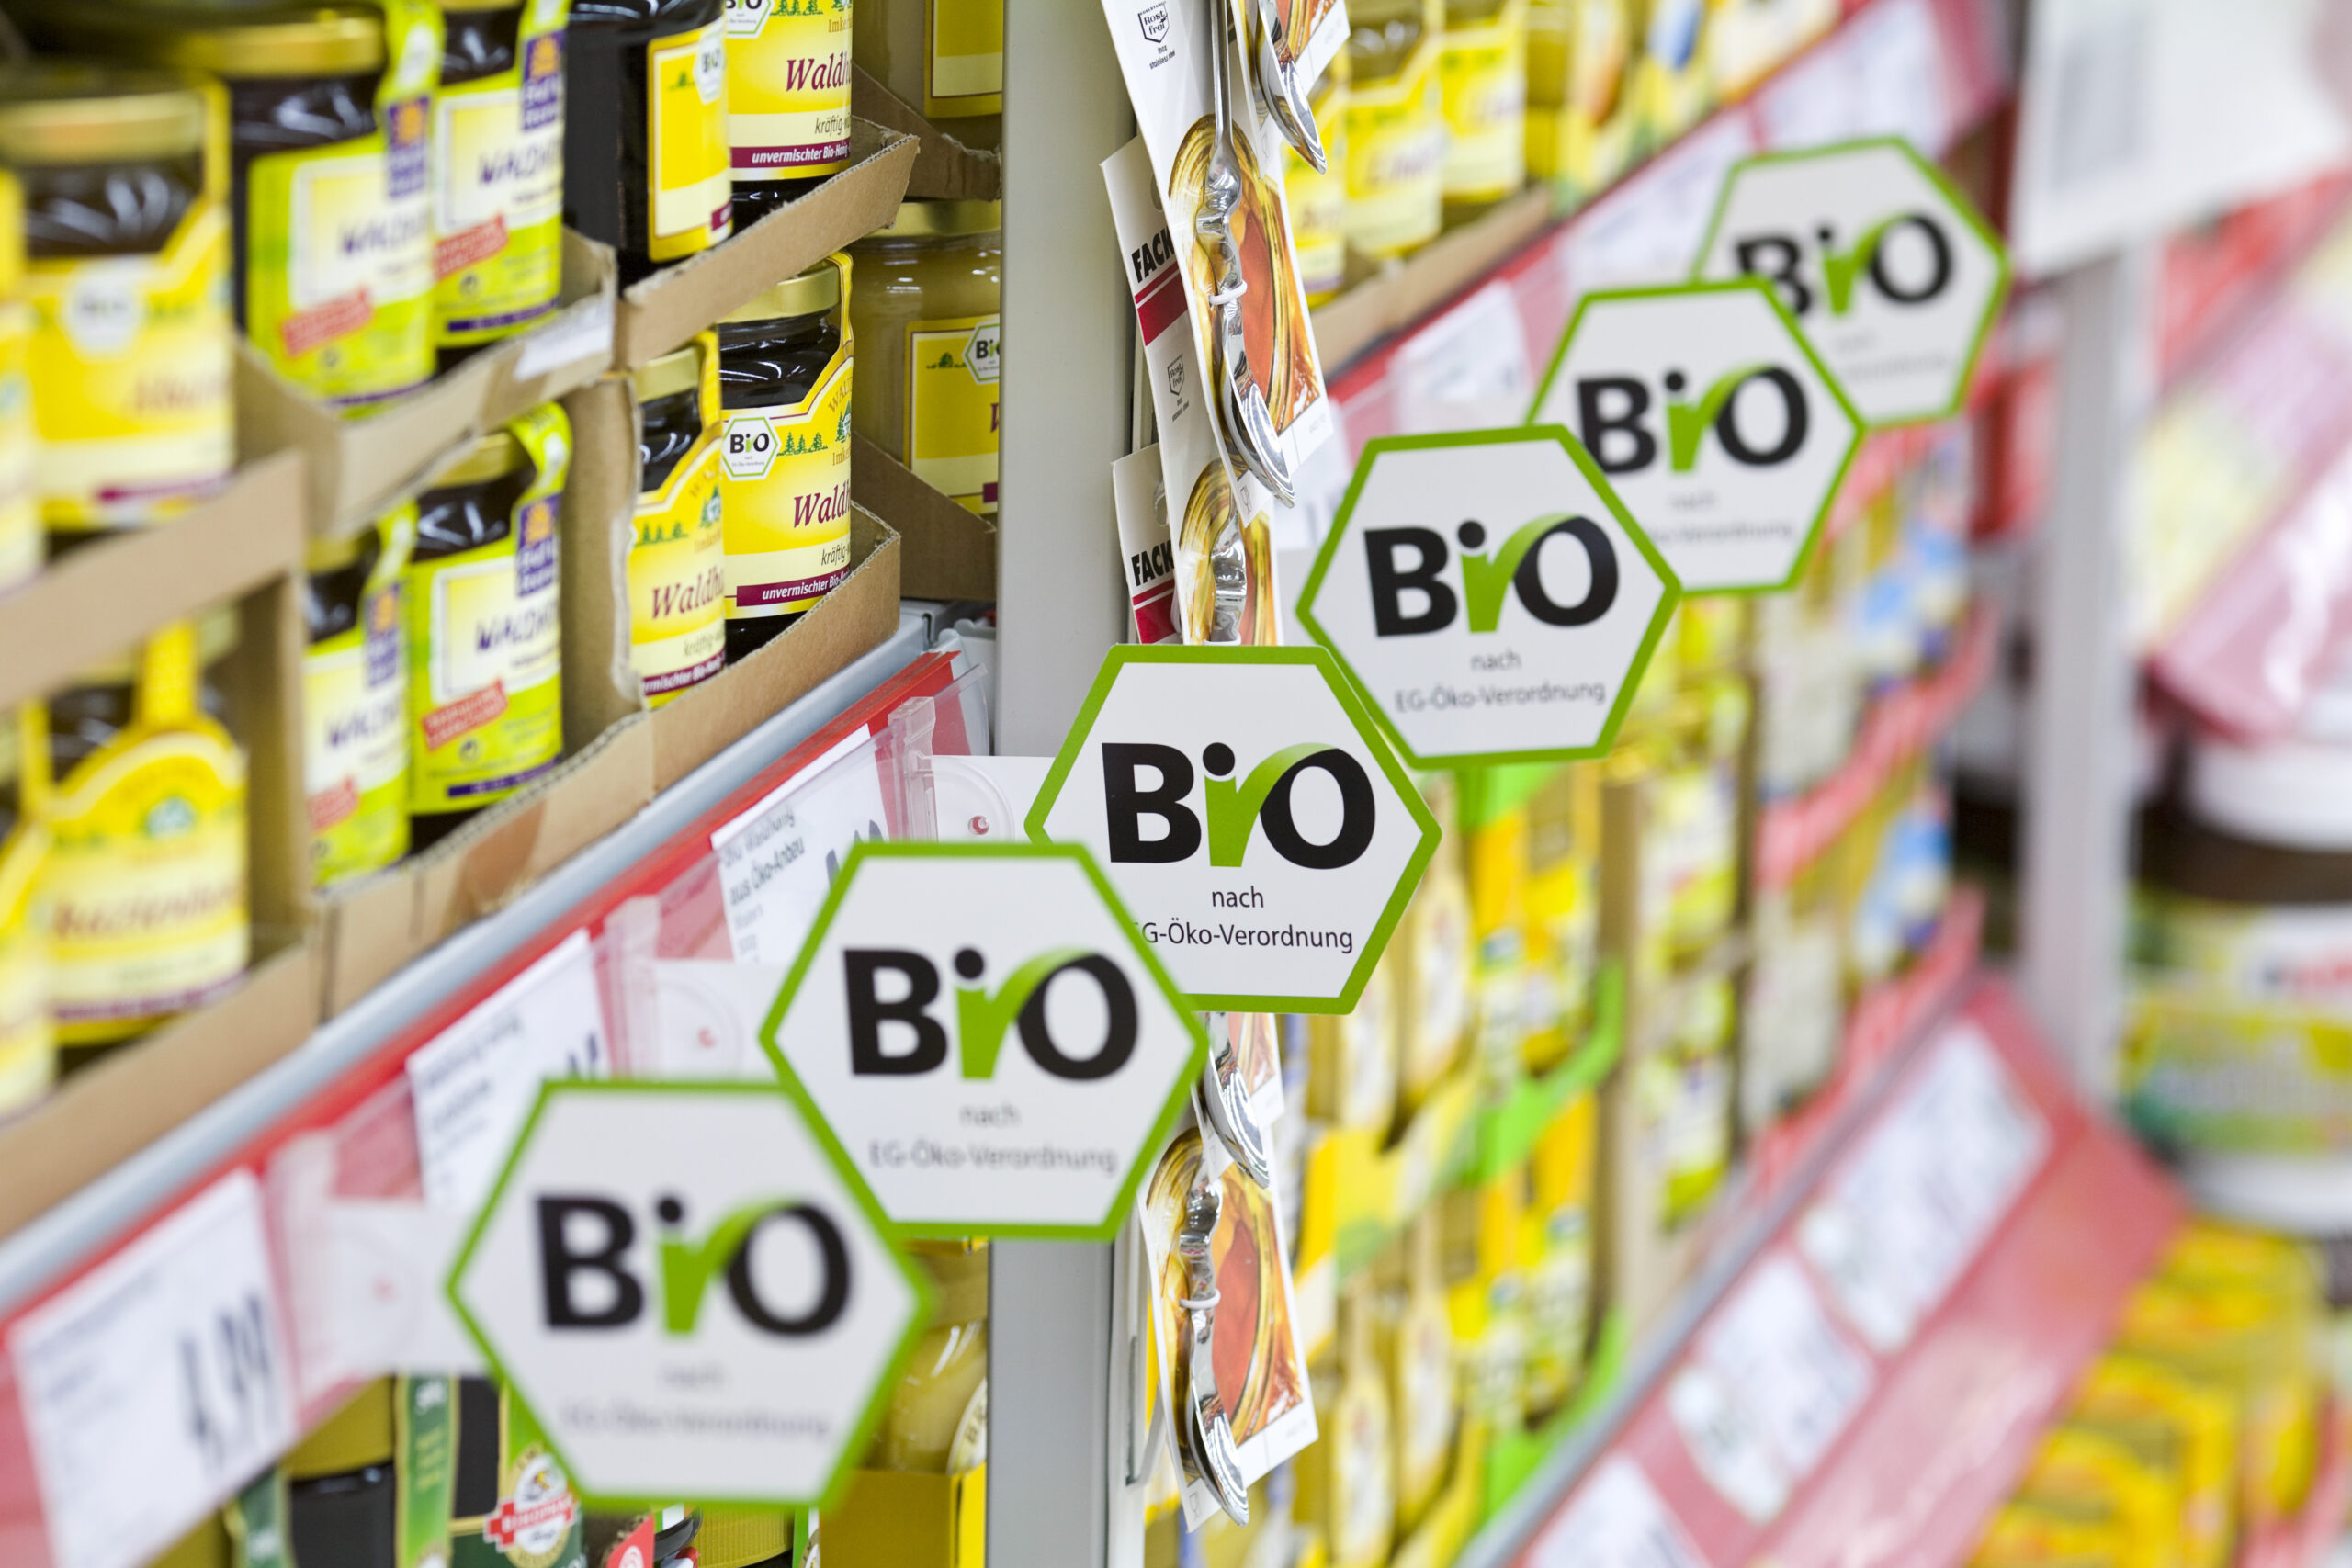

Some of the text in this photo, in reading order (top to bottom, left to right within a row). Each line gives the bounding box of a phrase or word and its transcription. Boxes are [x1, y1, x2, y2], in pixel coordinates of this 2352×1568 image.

[752, 147, 822, 164] unvermischter
[976, 340, 999, 359] Bi
[762, 580, 828, 600] unvermischter
[1471, 649, 1521, 671] nach
[1395, 681, 1606, 712] EG-Öko-Verordnung
[1212, 886, 1264, 908] nach
[1136, 918, 1353, 953] G-Öko-Verordnung
